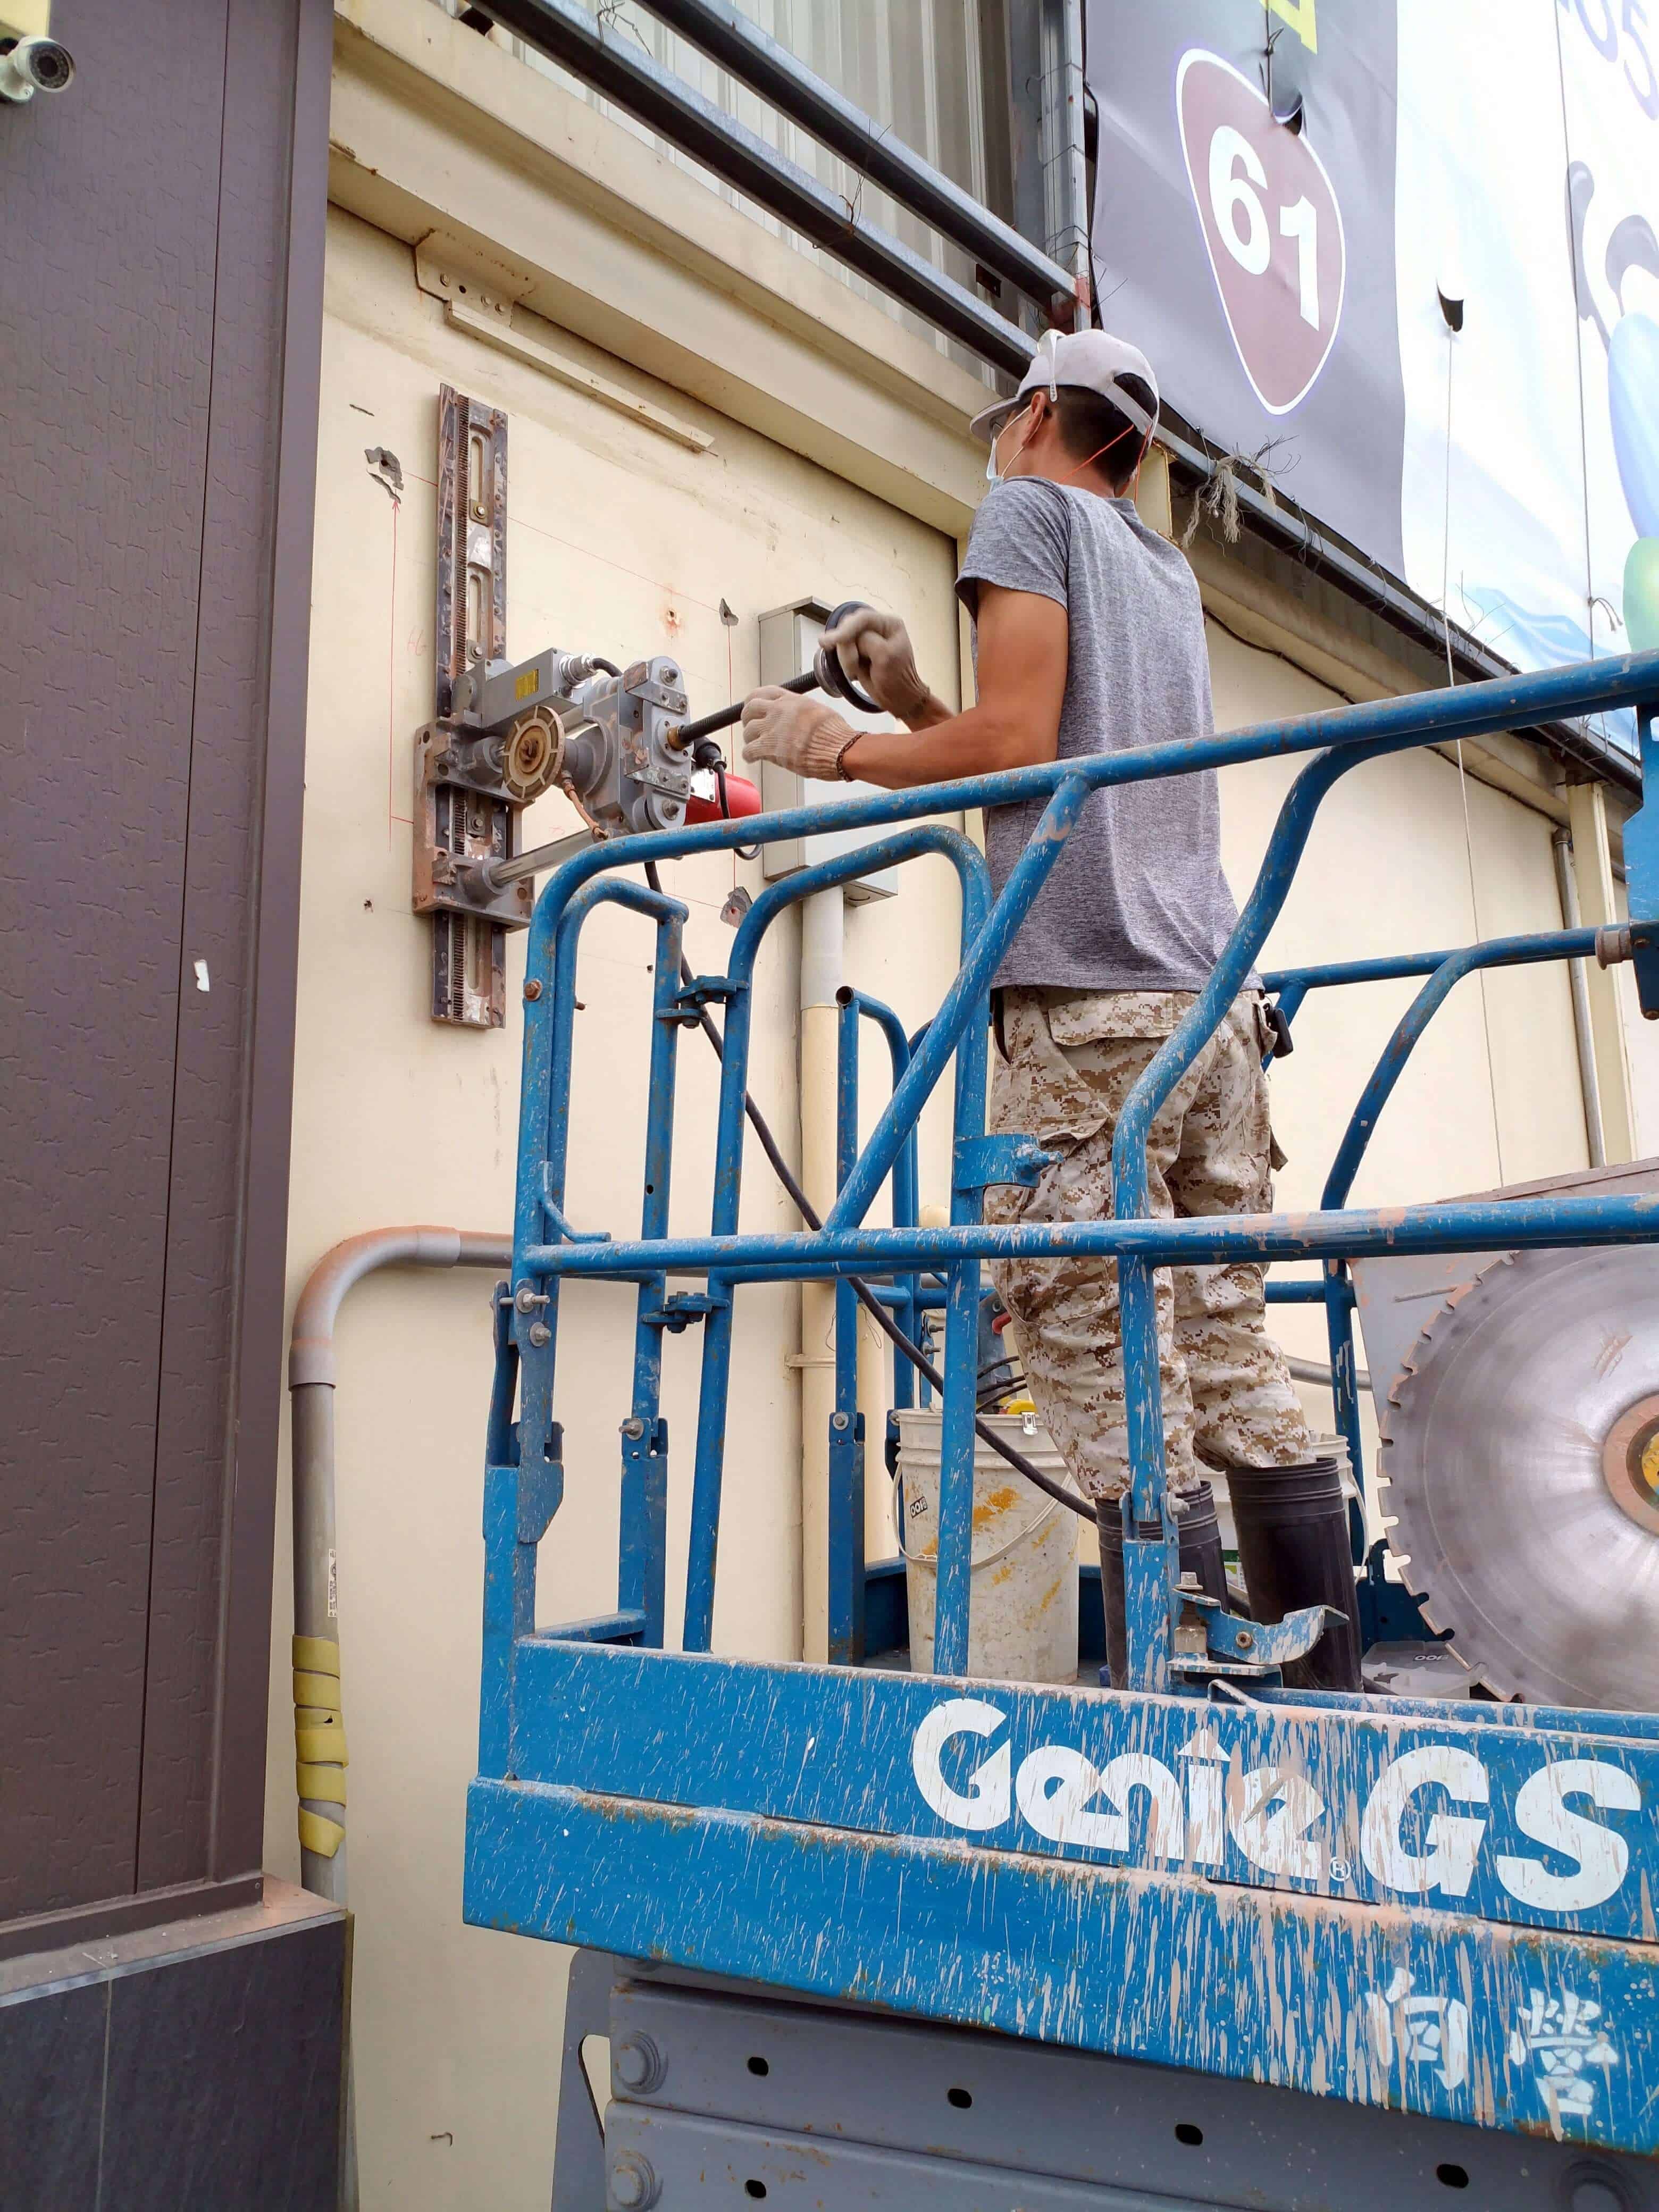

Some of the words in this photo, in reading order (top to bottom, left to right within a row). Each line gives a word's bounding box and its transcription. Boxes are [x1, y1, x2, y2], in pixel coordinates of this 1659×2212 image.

[1209, 125, 1319, 331] 61
[913, 1698, 1325, 1881] Genie
[1361, 1745, 1641, 1911] GS
